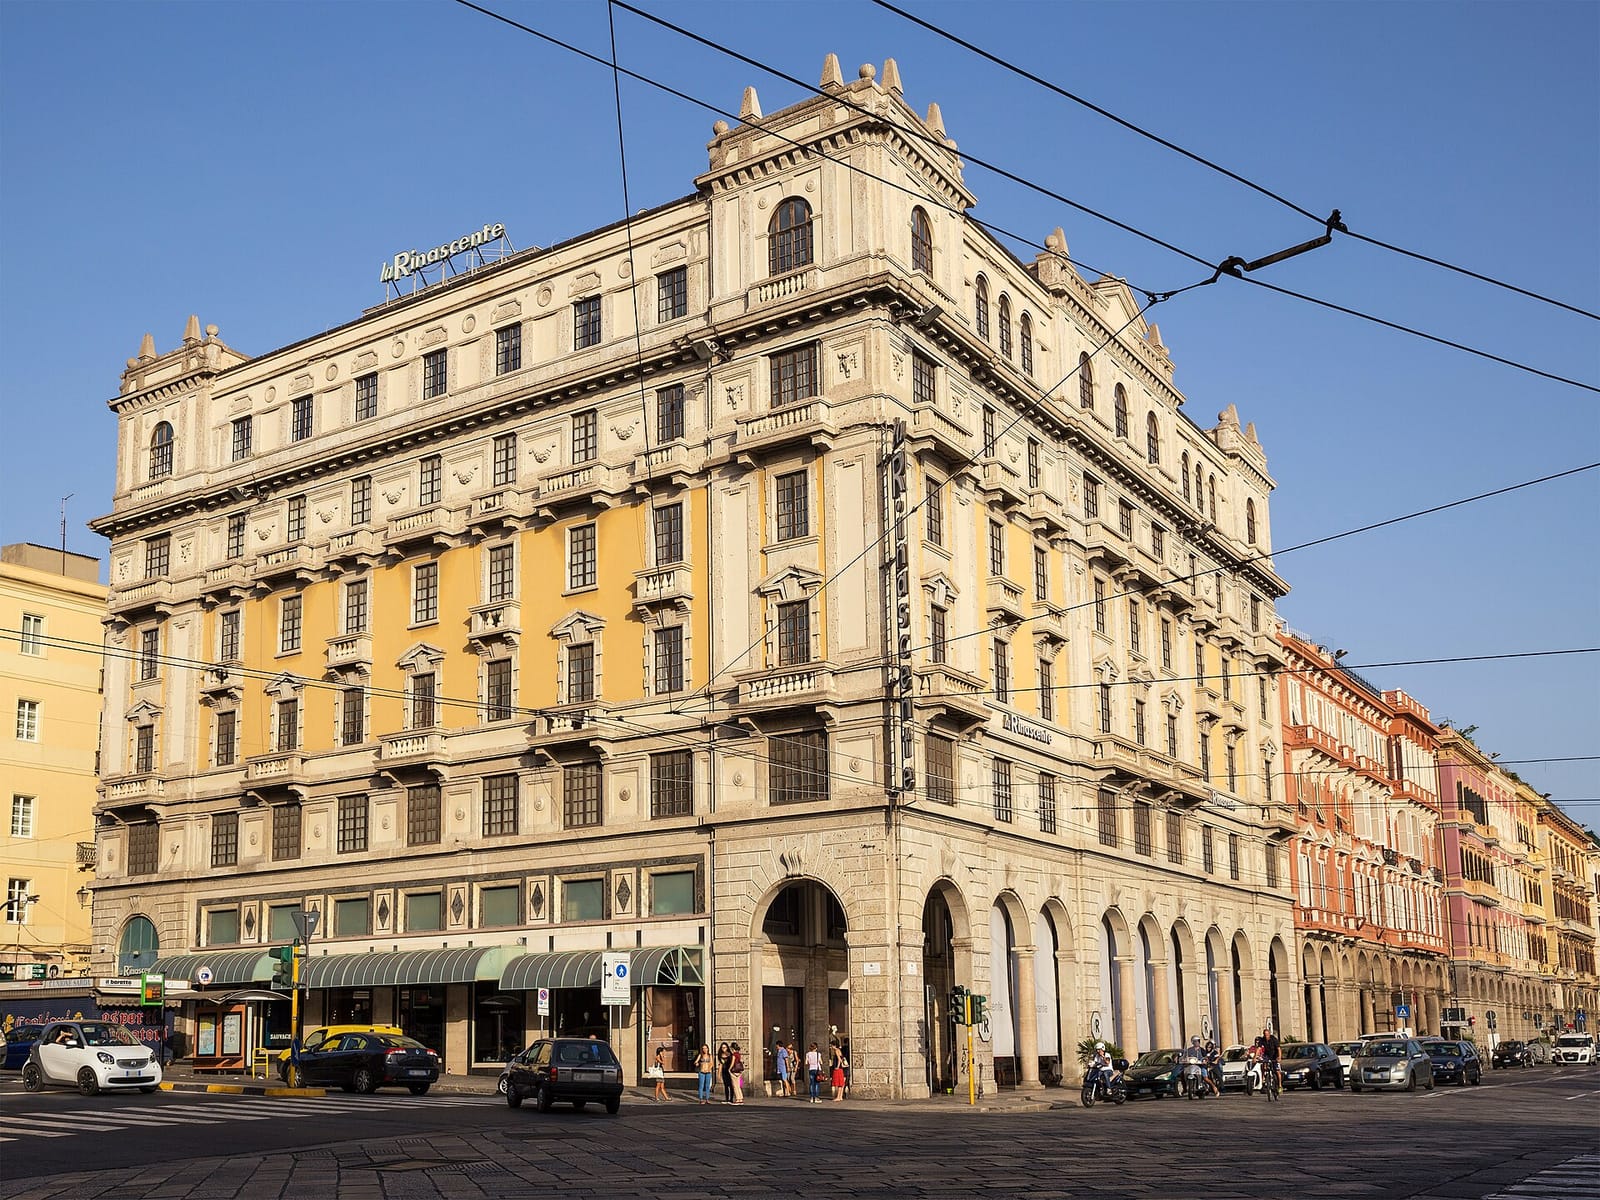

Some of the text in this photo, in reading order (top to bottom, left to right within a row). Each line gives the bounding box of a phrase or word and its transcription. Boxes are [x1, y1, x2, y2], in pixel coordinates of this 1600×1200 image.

[394, 222, 505, 281] Rinascente
[892, 450, 916, 792] Rinascente
[1010, 714, 1052, 745] Rinascente
